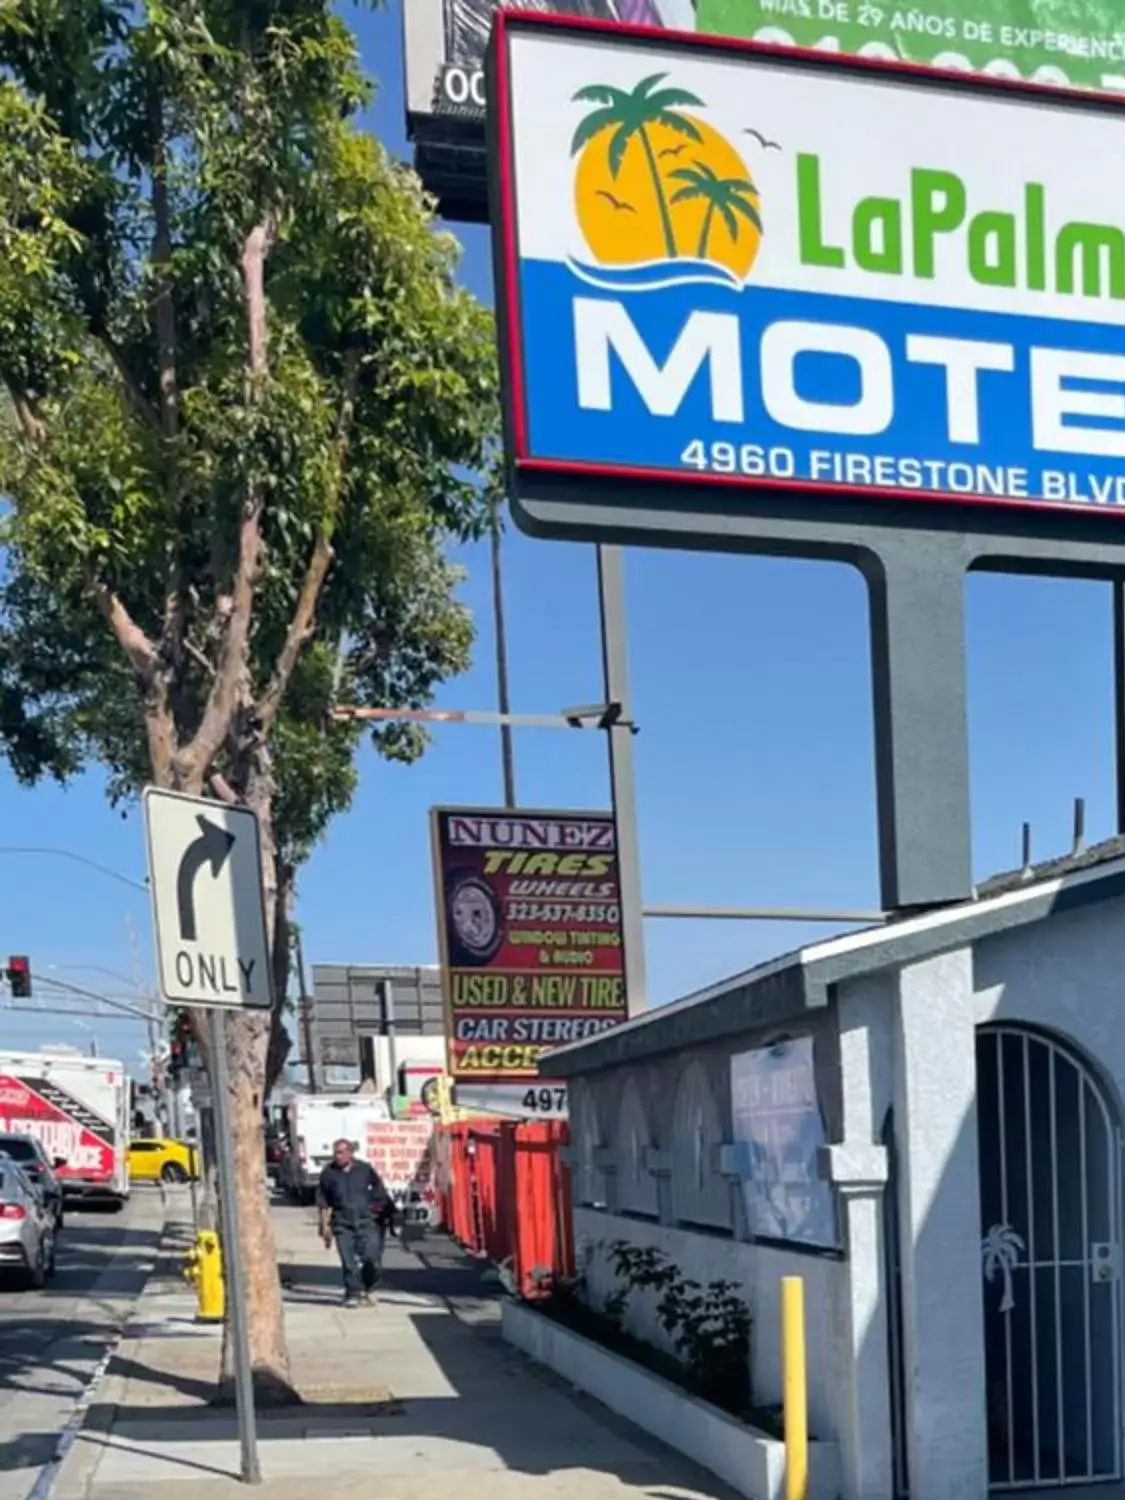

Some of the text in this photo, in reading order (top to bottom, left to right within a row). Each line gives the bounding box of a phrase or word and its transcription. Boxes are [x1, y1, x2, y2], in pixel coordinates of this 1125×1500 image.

[818, 0, 849, 23] DE
[857, 4, 884, 28] 29
[890, 9, 956, 38] AÑOS
[962, 20, 993, 43] DE
[681, 440, 794, 479] 4960
[809, 450, 1028, 497] FIRESTONE
[483, 852, 615, 876] TIRES
[508, 880, 616, 897] WHEELS
[176, 951, 256, 993] ONLY
[453, 975, 507, 1005] USED
[512, 976, 527, 1006] &
[532, 977, 576, 1007] NEW
[457, 1018, 507, 1040] CAR
